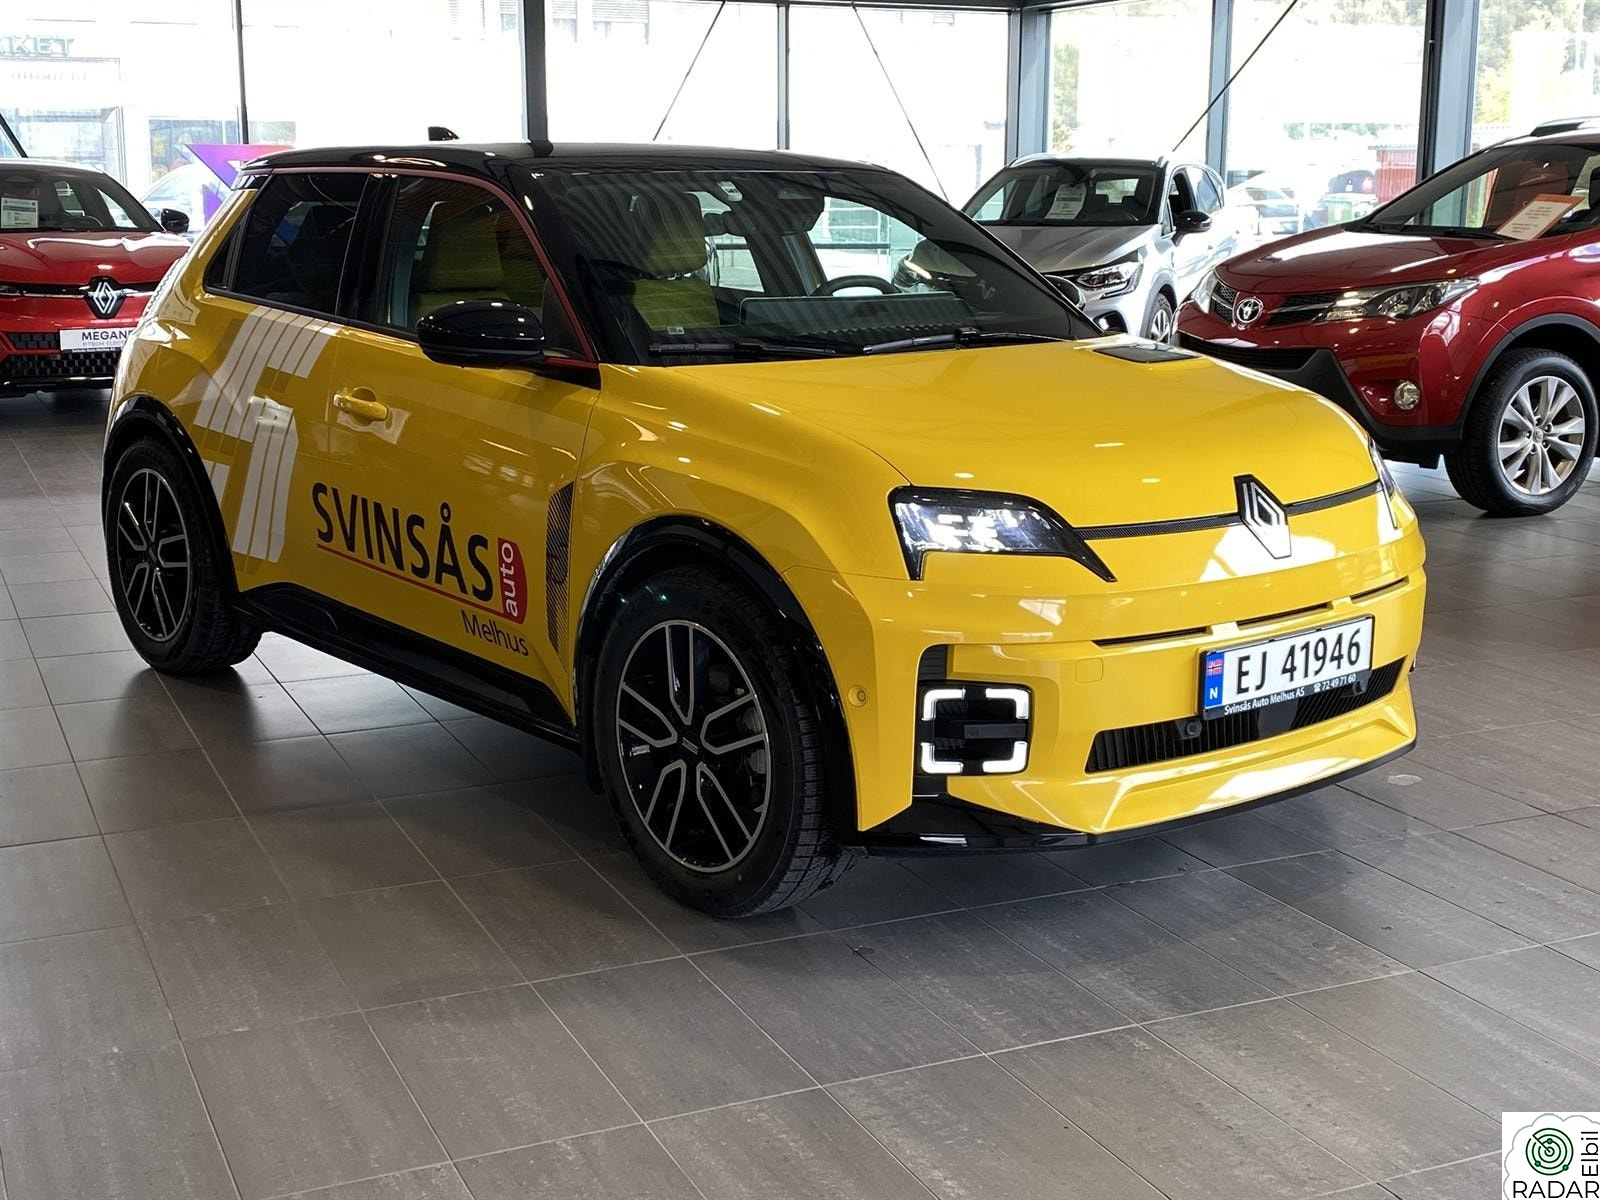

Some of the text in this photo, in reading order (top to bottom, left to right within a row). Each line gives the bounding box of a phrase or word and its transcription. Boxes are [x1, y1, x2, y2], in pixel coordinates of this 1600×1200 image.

[312, 482, 494, 602] SVINSÅS
[499, 542, 518, 617] auto
[461, 609, 529, 657] Melhus
[1236, 628, 1361, 695] EJ 41946
[1209, 686, 1218, 699] N
[1224, 701, 1251, 716] Svinsås
[1252, 696, 1269, 709] Auto
[1270, 690, 1295, 705] Melhus
[1295, 688, 1305, 698] AS
